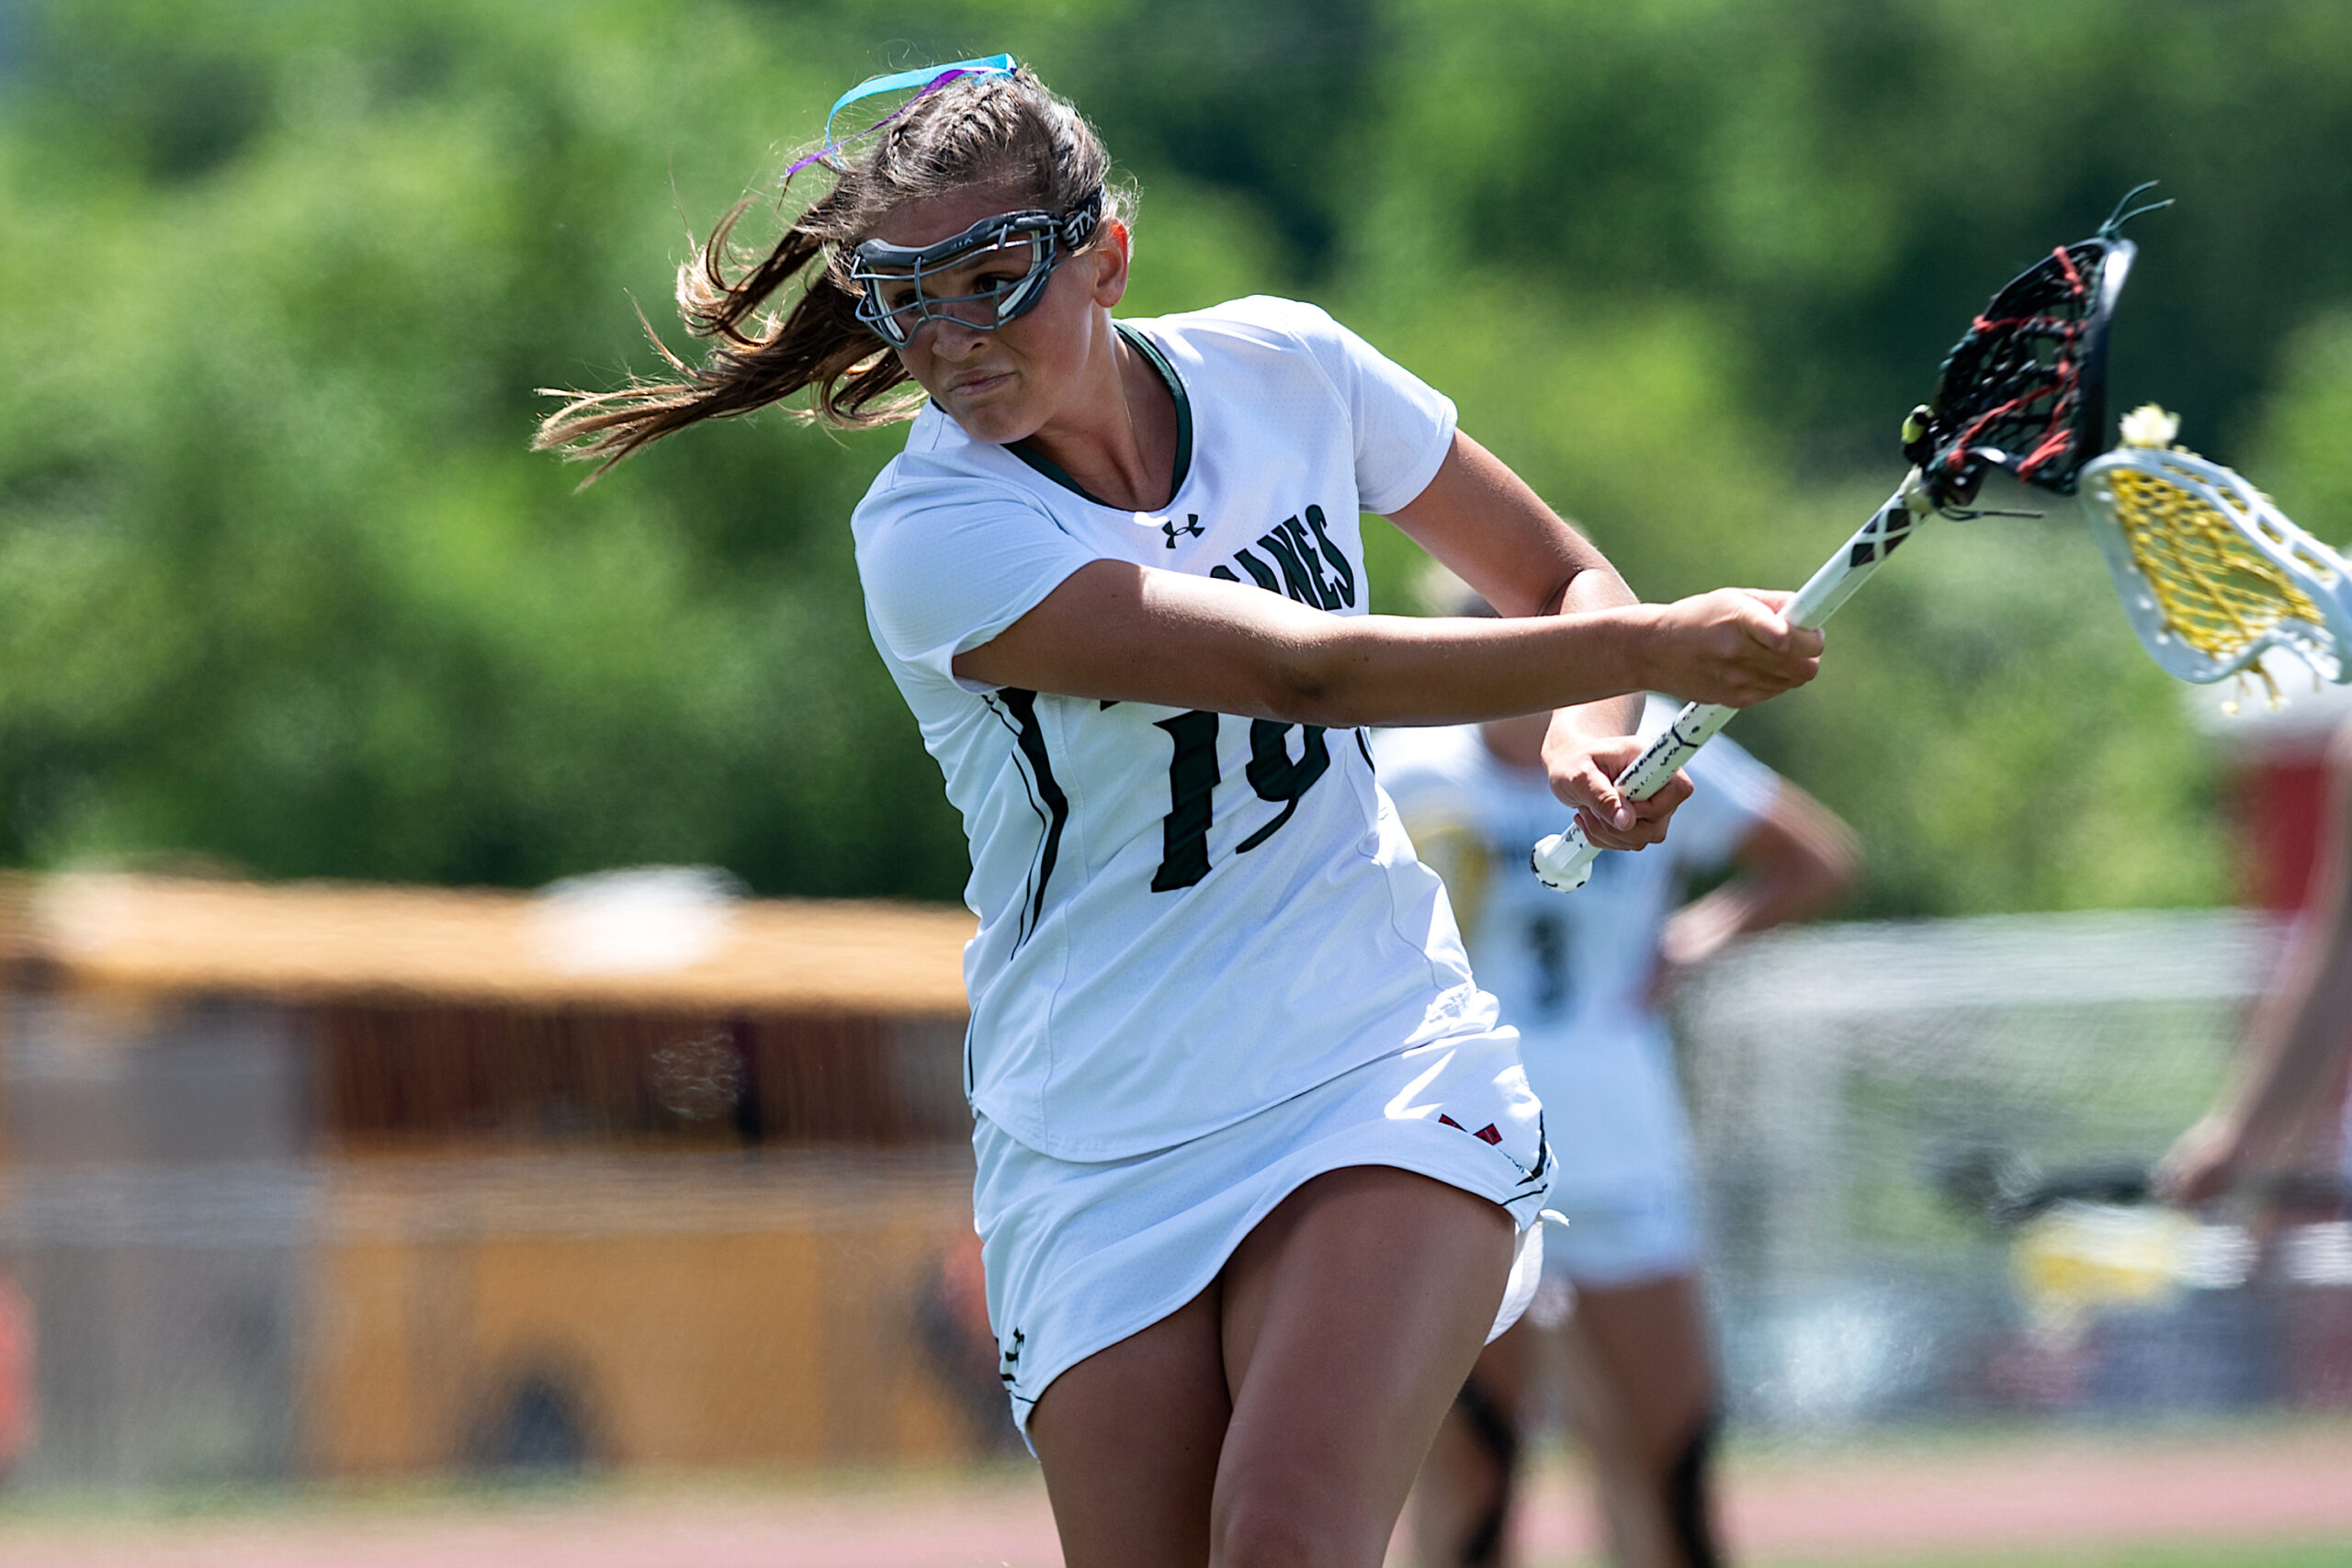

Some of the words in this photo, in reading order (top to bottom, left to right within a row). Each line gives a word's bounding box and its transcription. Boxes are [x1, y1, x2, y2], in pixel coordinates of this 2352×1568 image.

[1061, 204, 1096, 246] STX
[1210, 504, 1355, 611] ANES
[1151, 710, 1331, 893] 19
